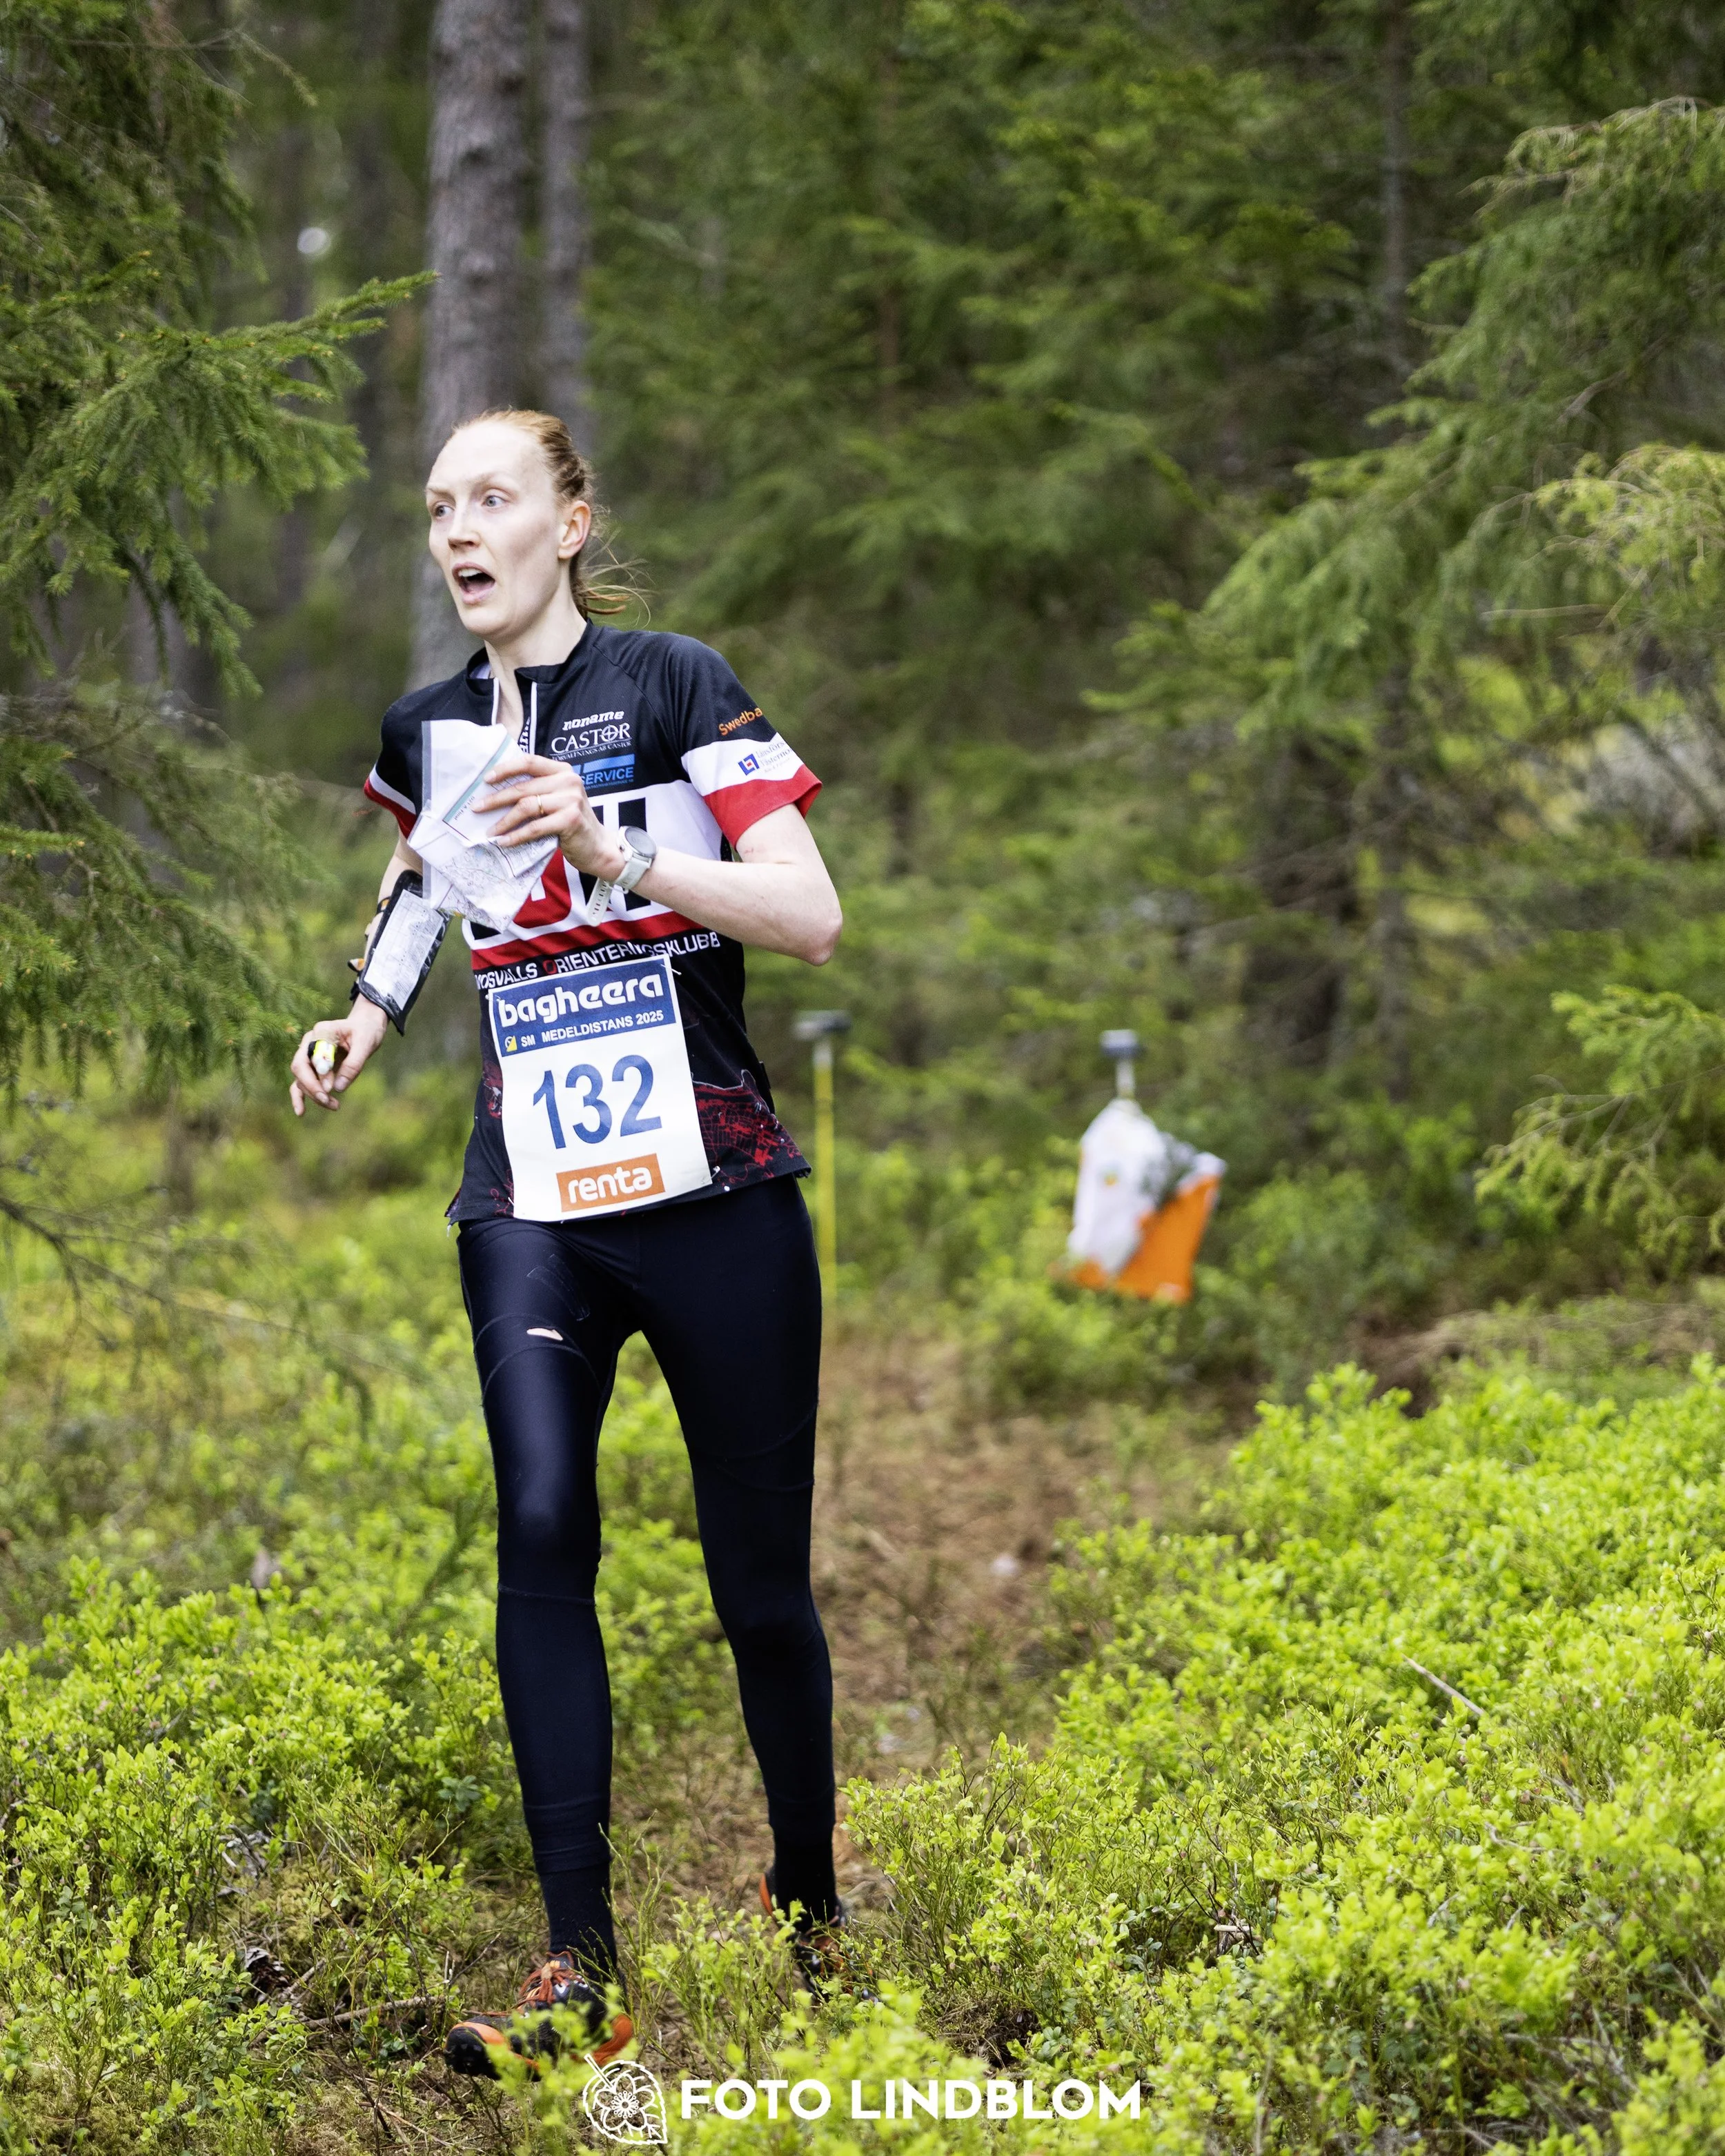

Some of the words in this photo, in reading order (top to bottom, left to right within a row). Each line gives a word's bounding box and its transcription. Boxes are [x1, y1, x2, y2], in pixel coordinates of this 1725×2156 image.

[551, 722, 631, 753] CASTOR
[562, 711, 624, 731] noname
[719, 707, 762, 736] Swedba
[500, 973, 664, 1027] bagheera
[521, 1034, 535, 1047] SM
[542, 1016, 633, 1043] MEDELDISTANS
[636, 1010, 664, 1025] 2025
[533, 1054, 662, 1149] 132
[567, 1166, 652, 1204] renta
